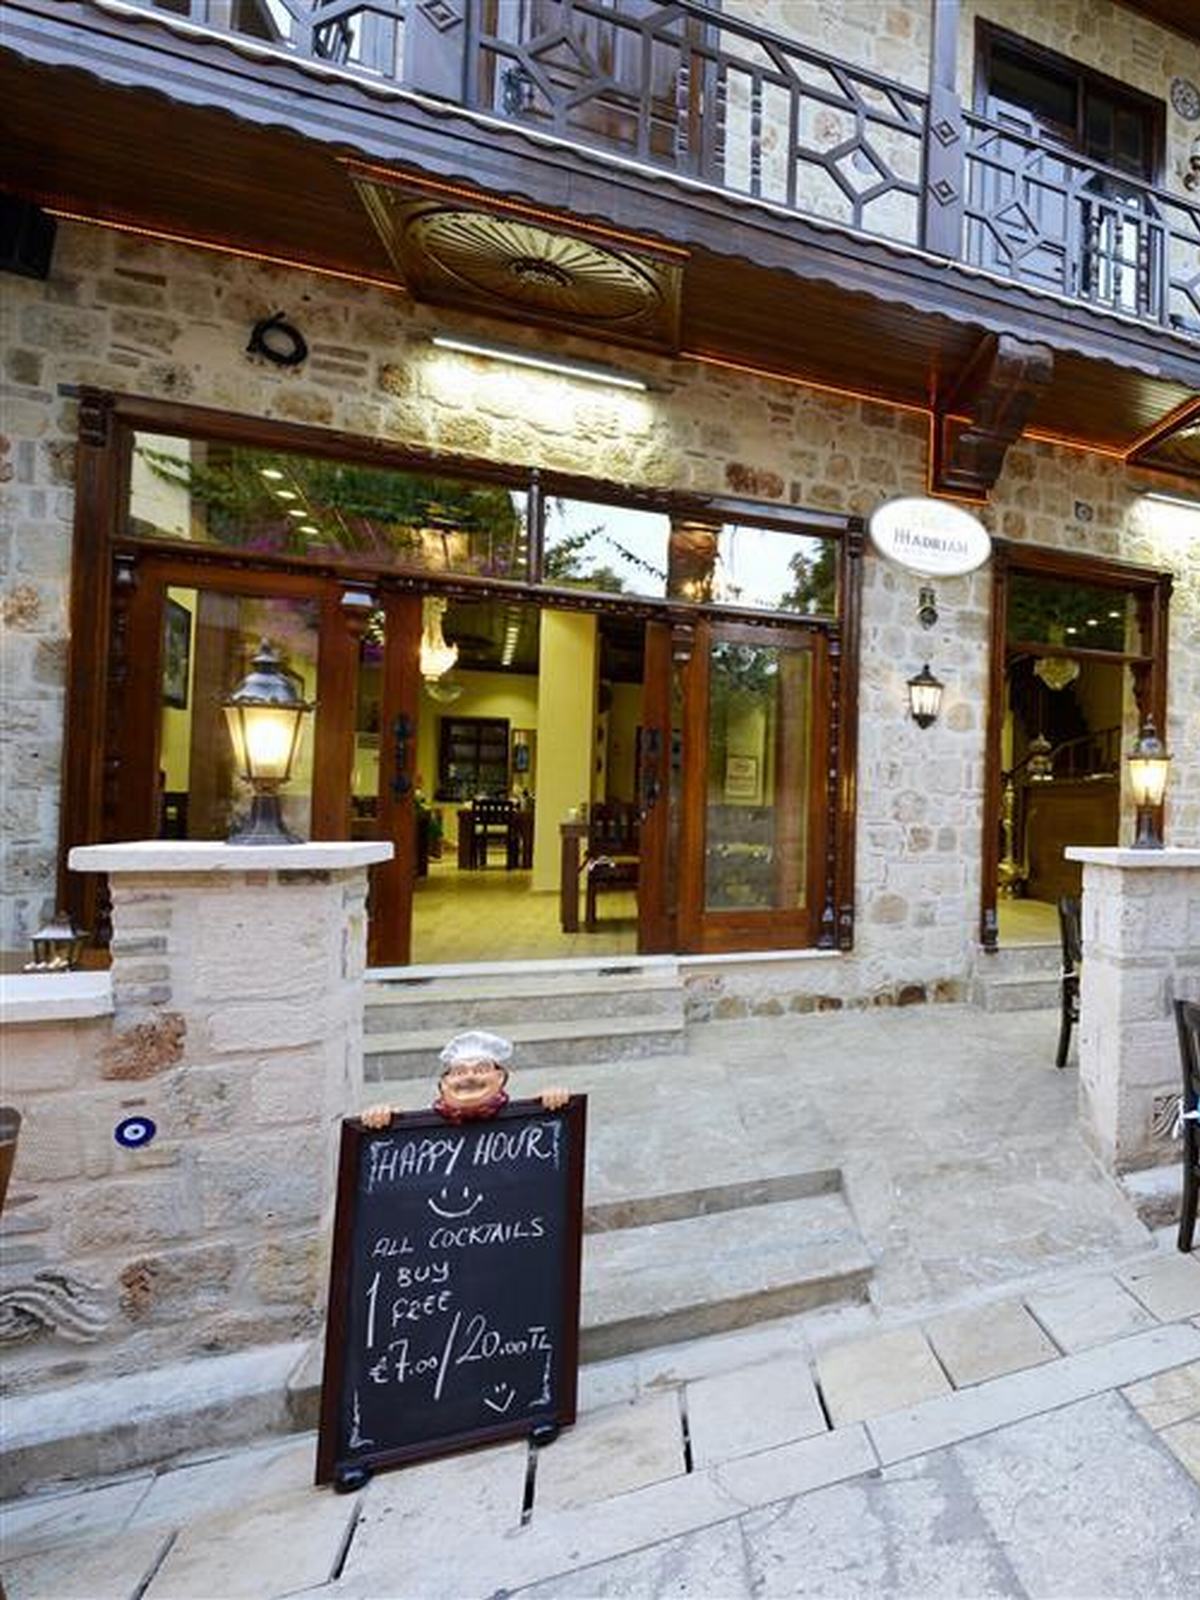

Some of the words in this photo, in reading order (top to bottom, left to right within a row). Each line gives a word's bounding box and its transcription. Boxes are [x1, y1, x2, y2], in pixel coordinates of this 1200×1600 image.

[378, 1137, 465, 1181] HAPPY
[473, 1124, 549, 1167] HOUR
[372, 1236, 414, 1258] ALL
[429, 1217, 544, 1250] COCKTAILS
[396, 1261, 450, 1288] BUY
